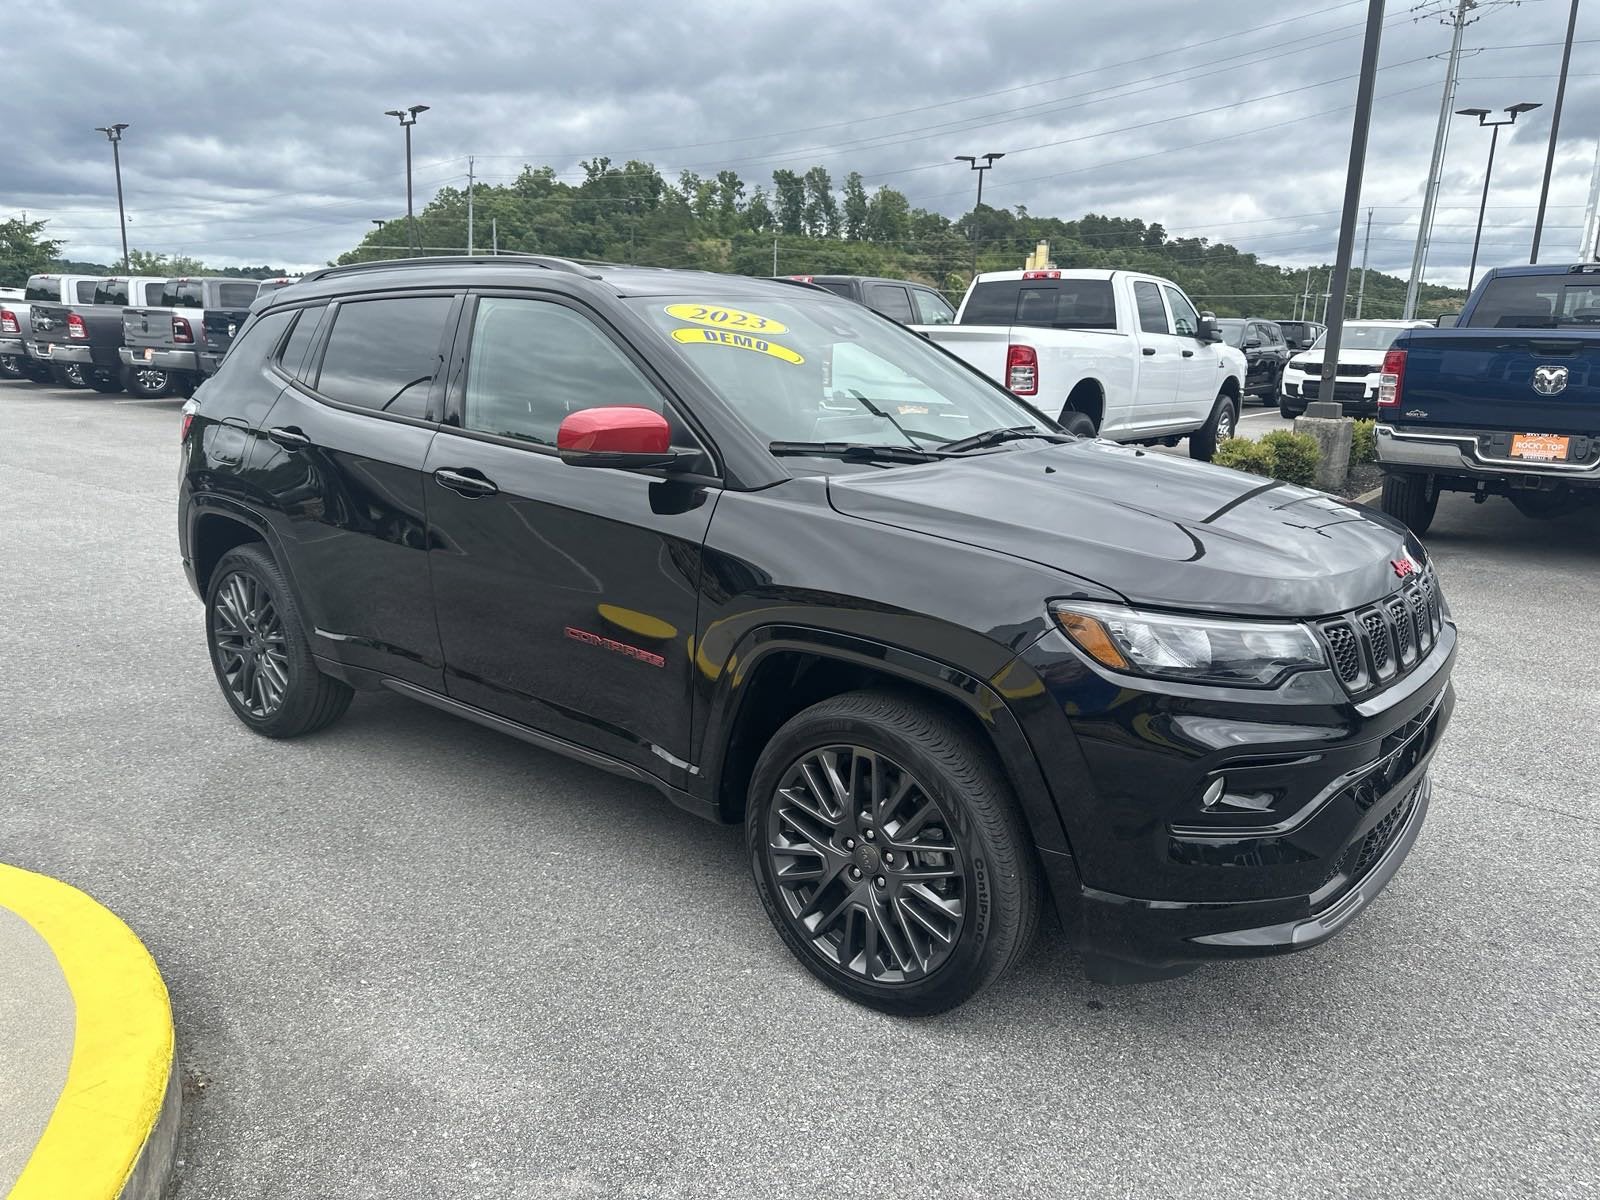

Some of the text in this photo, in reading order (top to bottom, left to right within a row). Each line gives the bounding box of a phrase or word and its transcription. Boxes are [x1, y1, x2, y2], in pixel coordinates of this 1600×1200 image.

[688, 307, 767, 329] 2023
[703, 330, 769, 351] DEMO
[1515, 441, 1565, 451] ROCKY TOP
[564, 626, 665, 668] COMPASS
